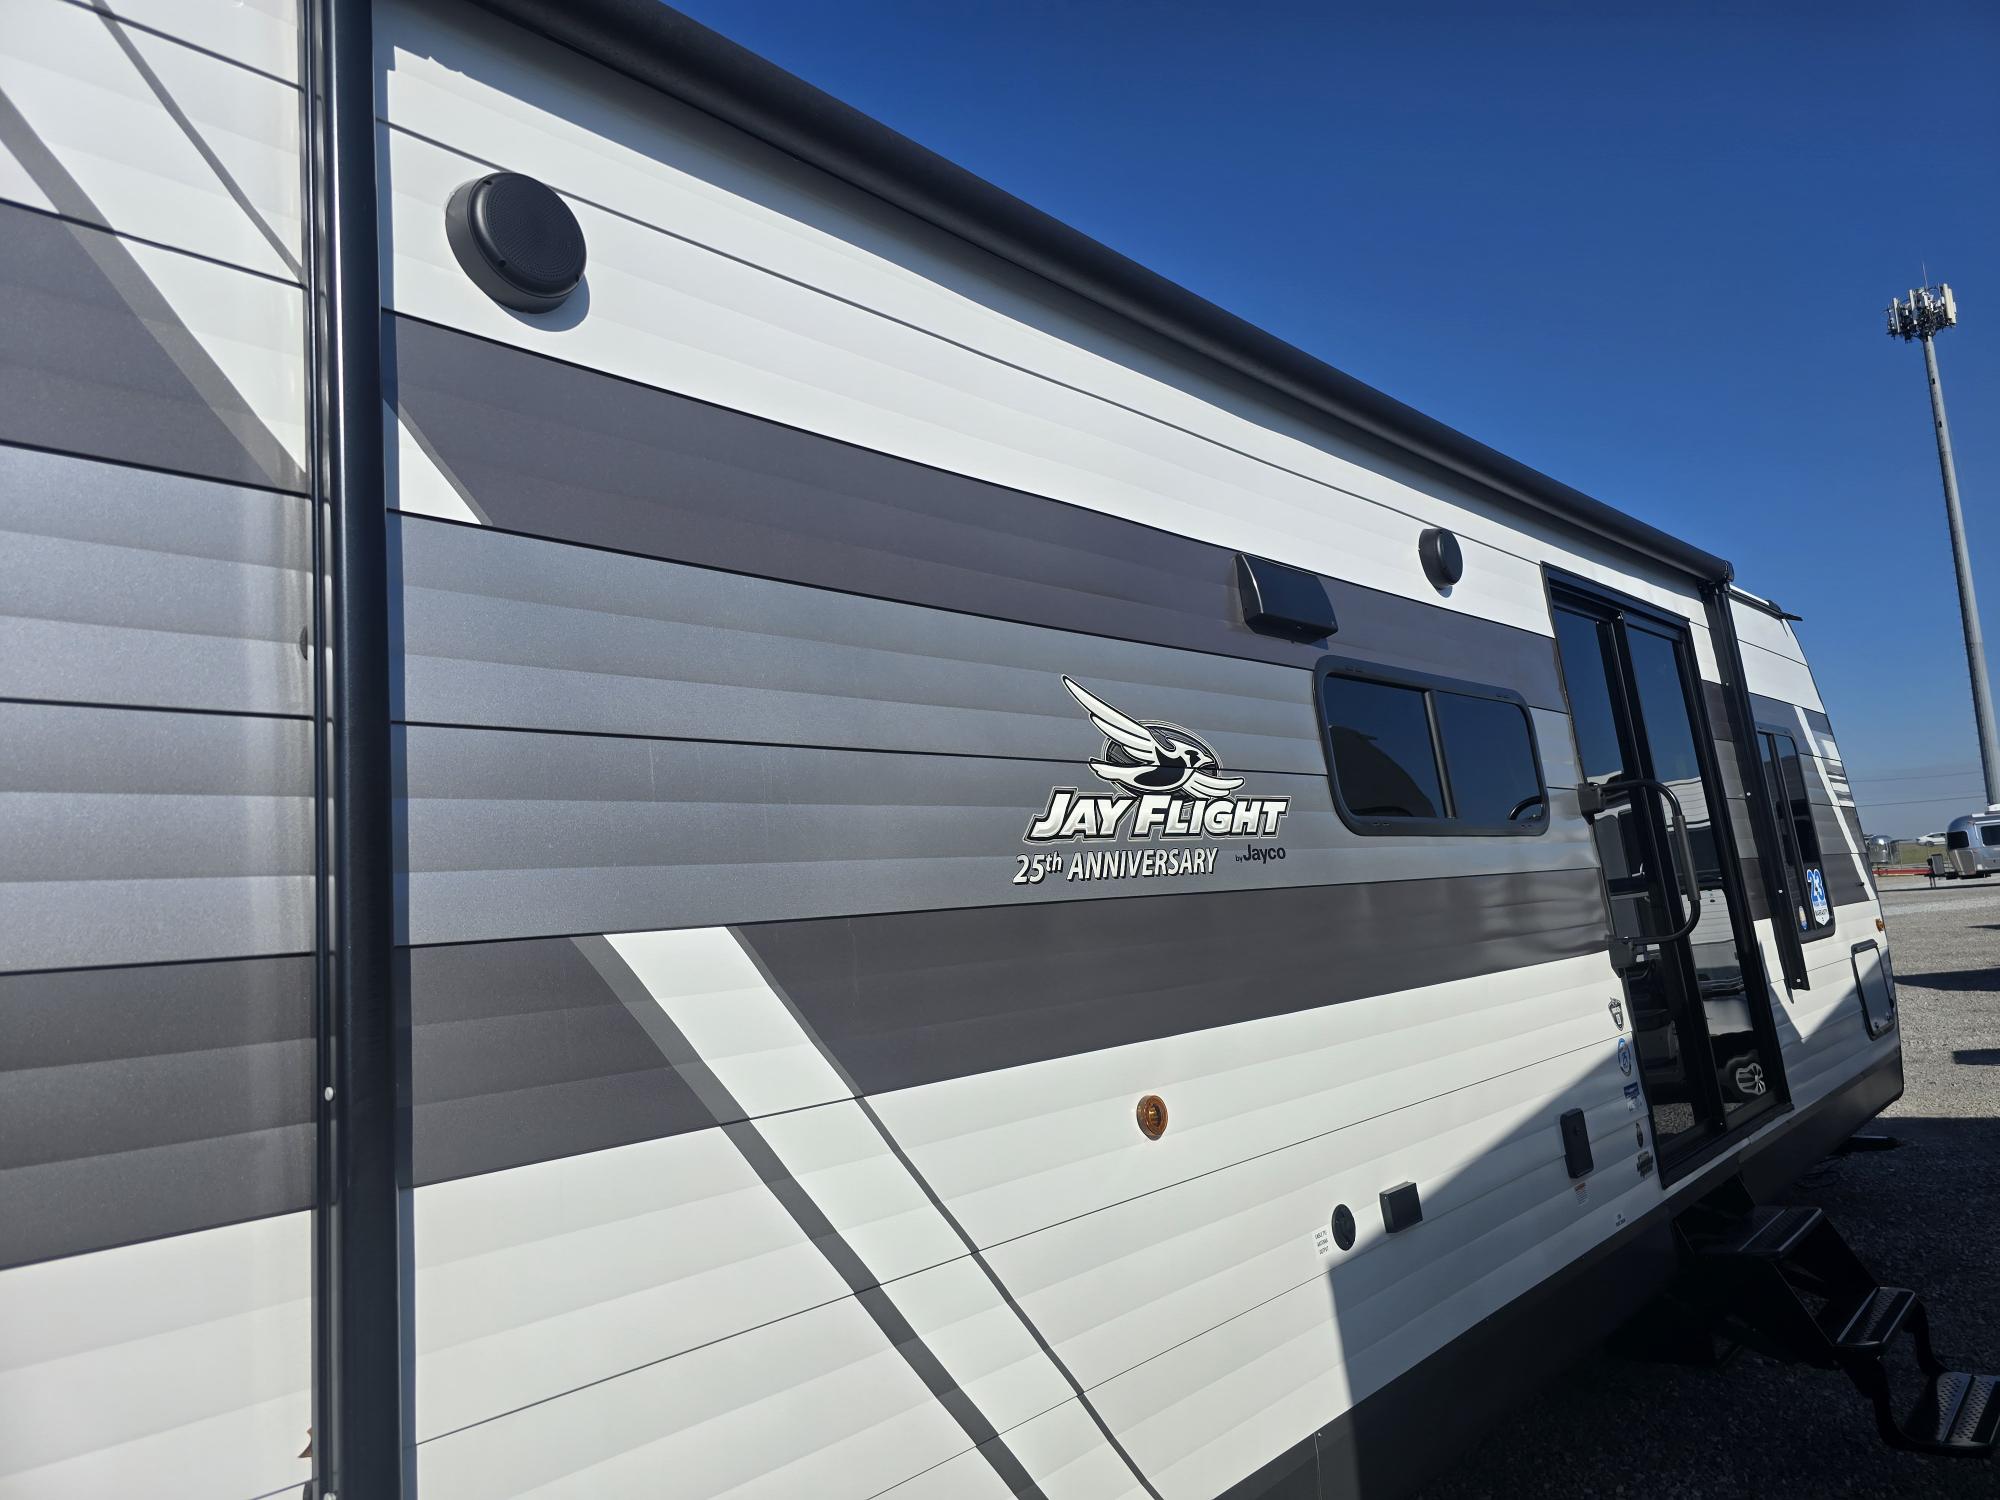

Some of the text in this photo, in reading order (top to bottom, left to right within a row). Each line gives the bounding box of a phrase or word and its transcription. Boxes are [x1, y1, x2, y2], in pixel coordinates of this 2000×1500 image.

[1025, 788, 1290, 841] JAY FLIGHT
[1012, 847, 1219, 884] 25th ANNIVERSARY
[1243, 844, 1286, 864] Jayco
